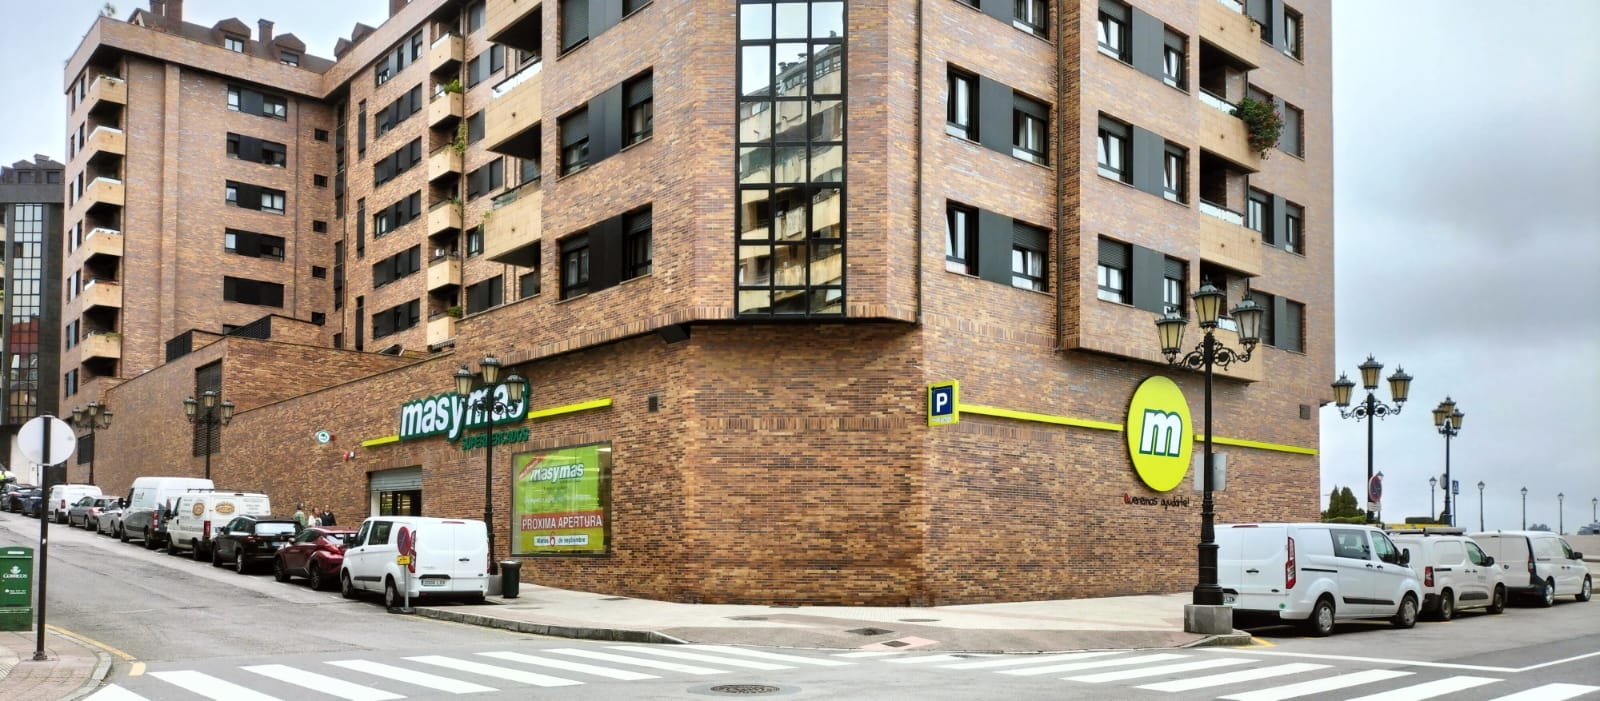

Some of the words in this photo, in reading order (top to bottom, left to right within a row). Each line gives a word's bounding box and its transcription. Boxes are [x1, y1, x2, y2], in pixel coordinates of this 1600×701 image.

[936, 392, 948, 413] P
[461, 427, 529, 450] SUPERERCADOS
[1139, 408, 1183, 458] m
[529, 463, 584, 483] masymas
[558, 515, 604, 529] APERTURA
[549, 531, 556, 547] 6
